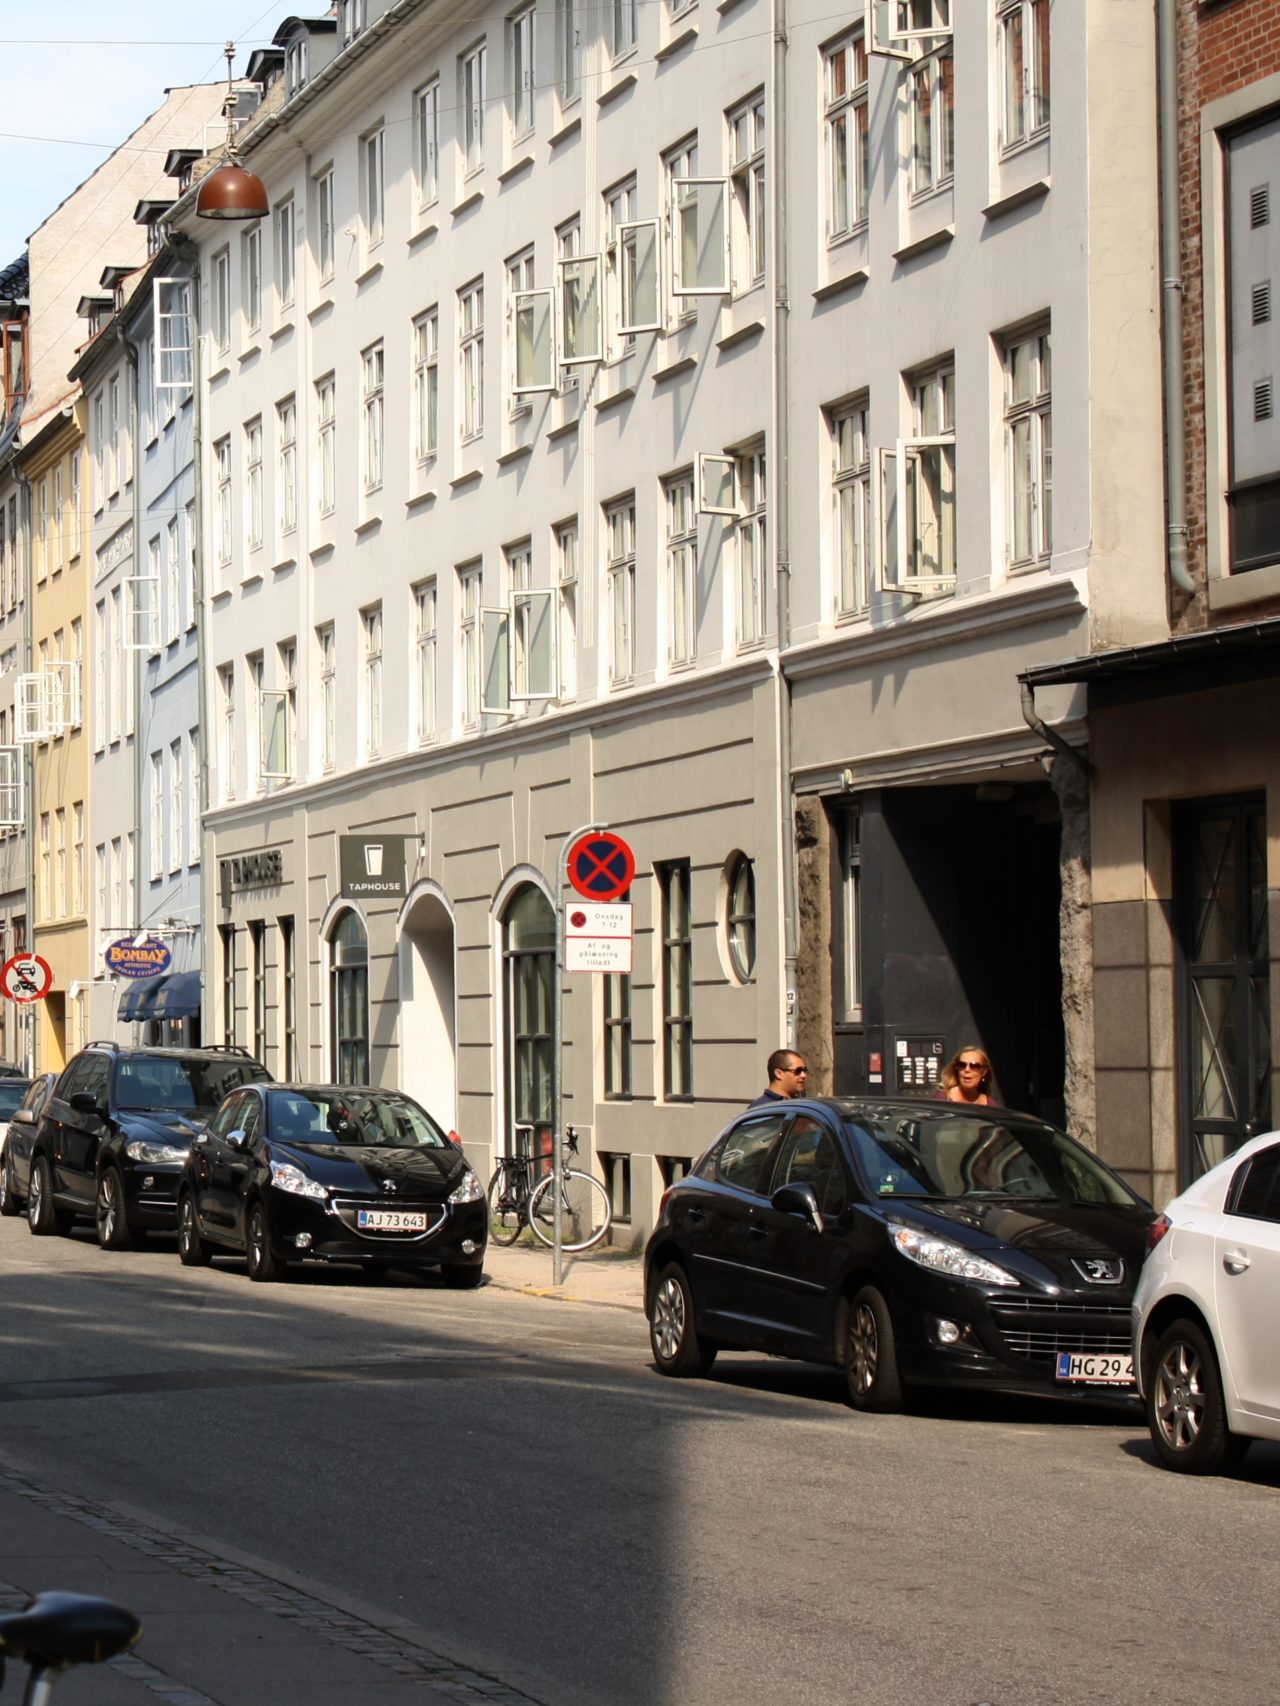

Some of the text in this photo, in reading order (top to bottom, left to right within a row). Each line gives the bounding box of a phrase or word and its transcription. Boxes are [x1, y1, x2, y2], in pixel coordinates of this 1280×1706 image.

[349, 882, 400, 891] TAPHOUSE
[594, 912, 624, 921] Onsdag
[110, 946, 167, 964] BOMBAY
[367, 1214, 383, 1226] AJ
[386, 1214, 400, 1226] 73
[402, 1215, 424, 1228] 643
[1070, 1358, 1095, 1376] HG
[1099, 1359, 1121, 1377] 29
